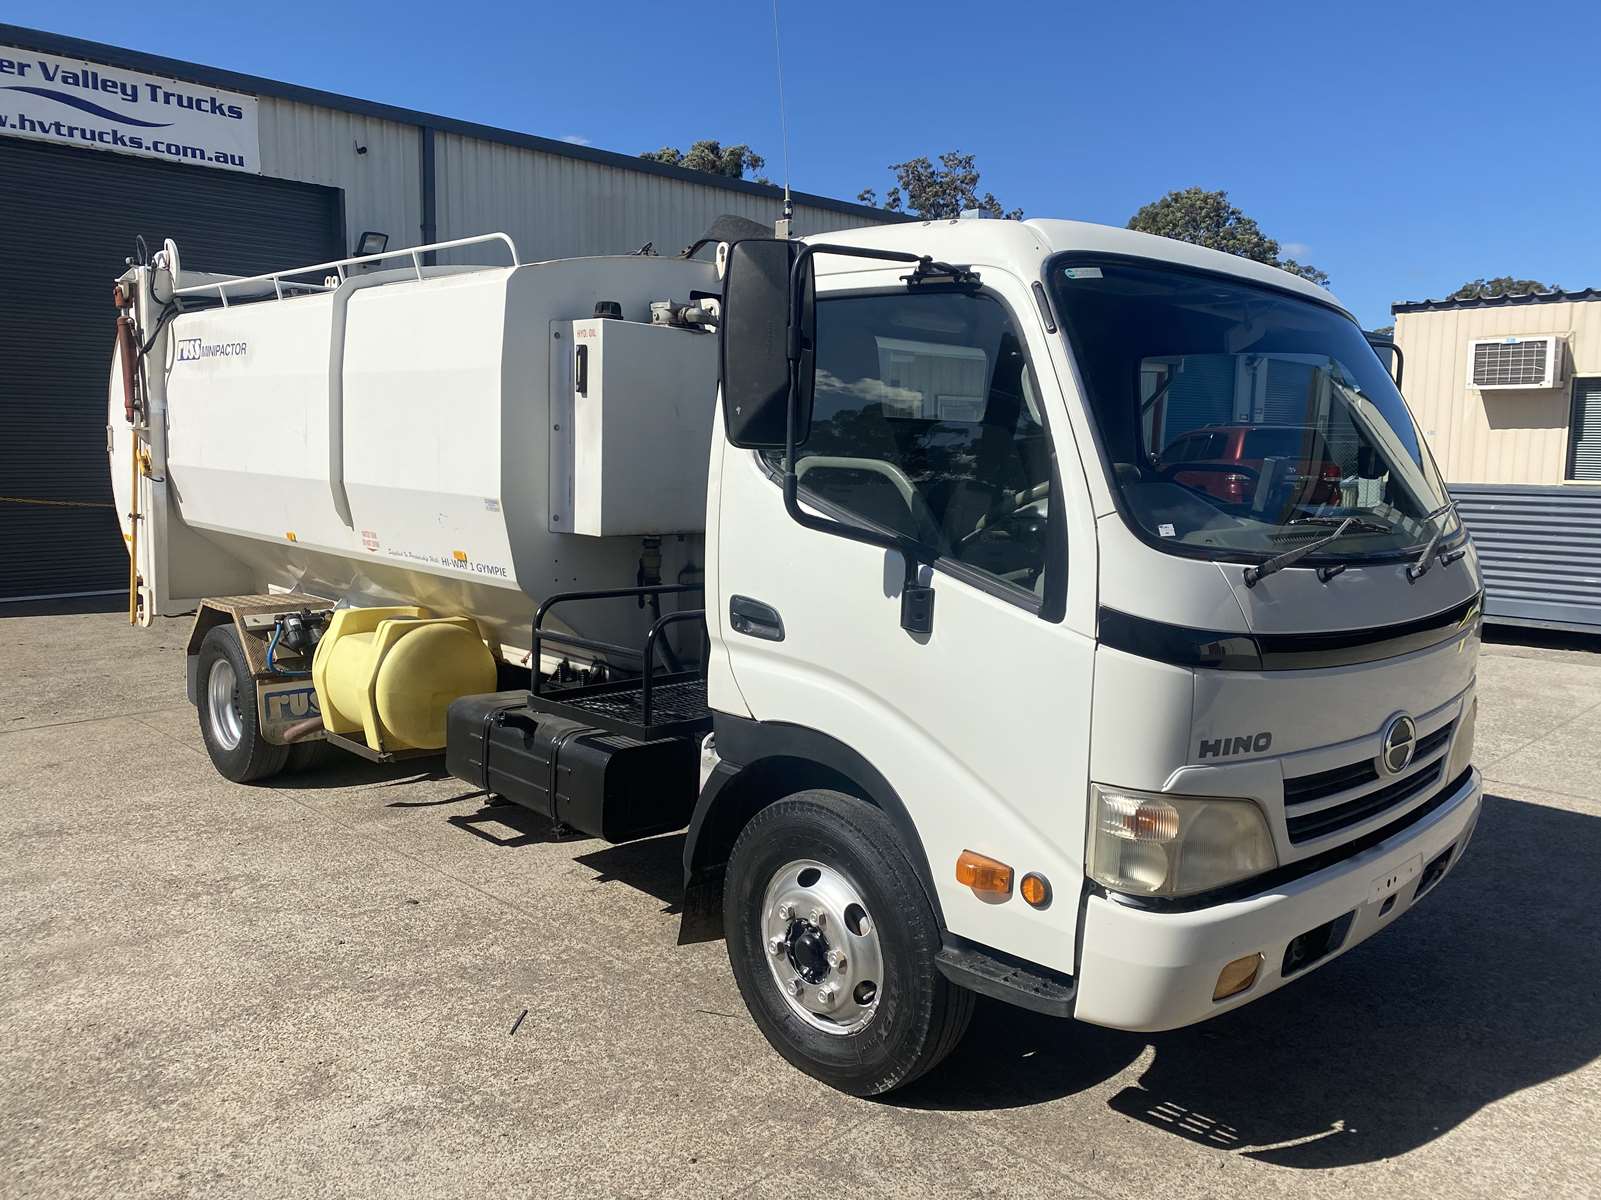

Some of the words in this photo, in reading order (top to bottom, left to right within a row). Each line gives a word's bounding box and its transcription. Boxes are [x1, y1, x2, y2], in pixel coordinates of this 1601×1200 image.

[0, 58, 31, 77] er
[38, 61, 138, 103] Valley
[145, 83, 243, 120] Trucks
[202, 343, 246, 357] MINIPACTOR
[441, 557, 468, 571] HI-WAY
[470, 562, 475, 572] 1
[476, 563, 508, 577] GYMPIE
[1199, 732, 1272, 758] HINO
